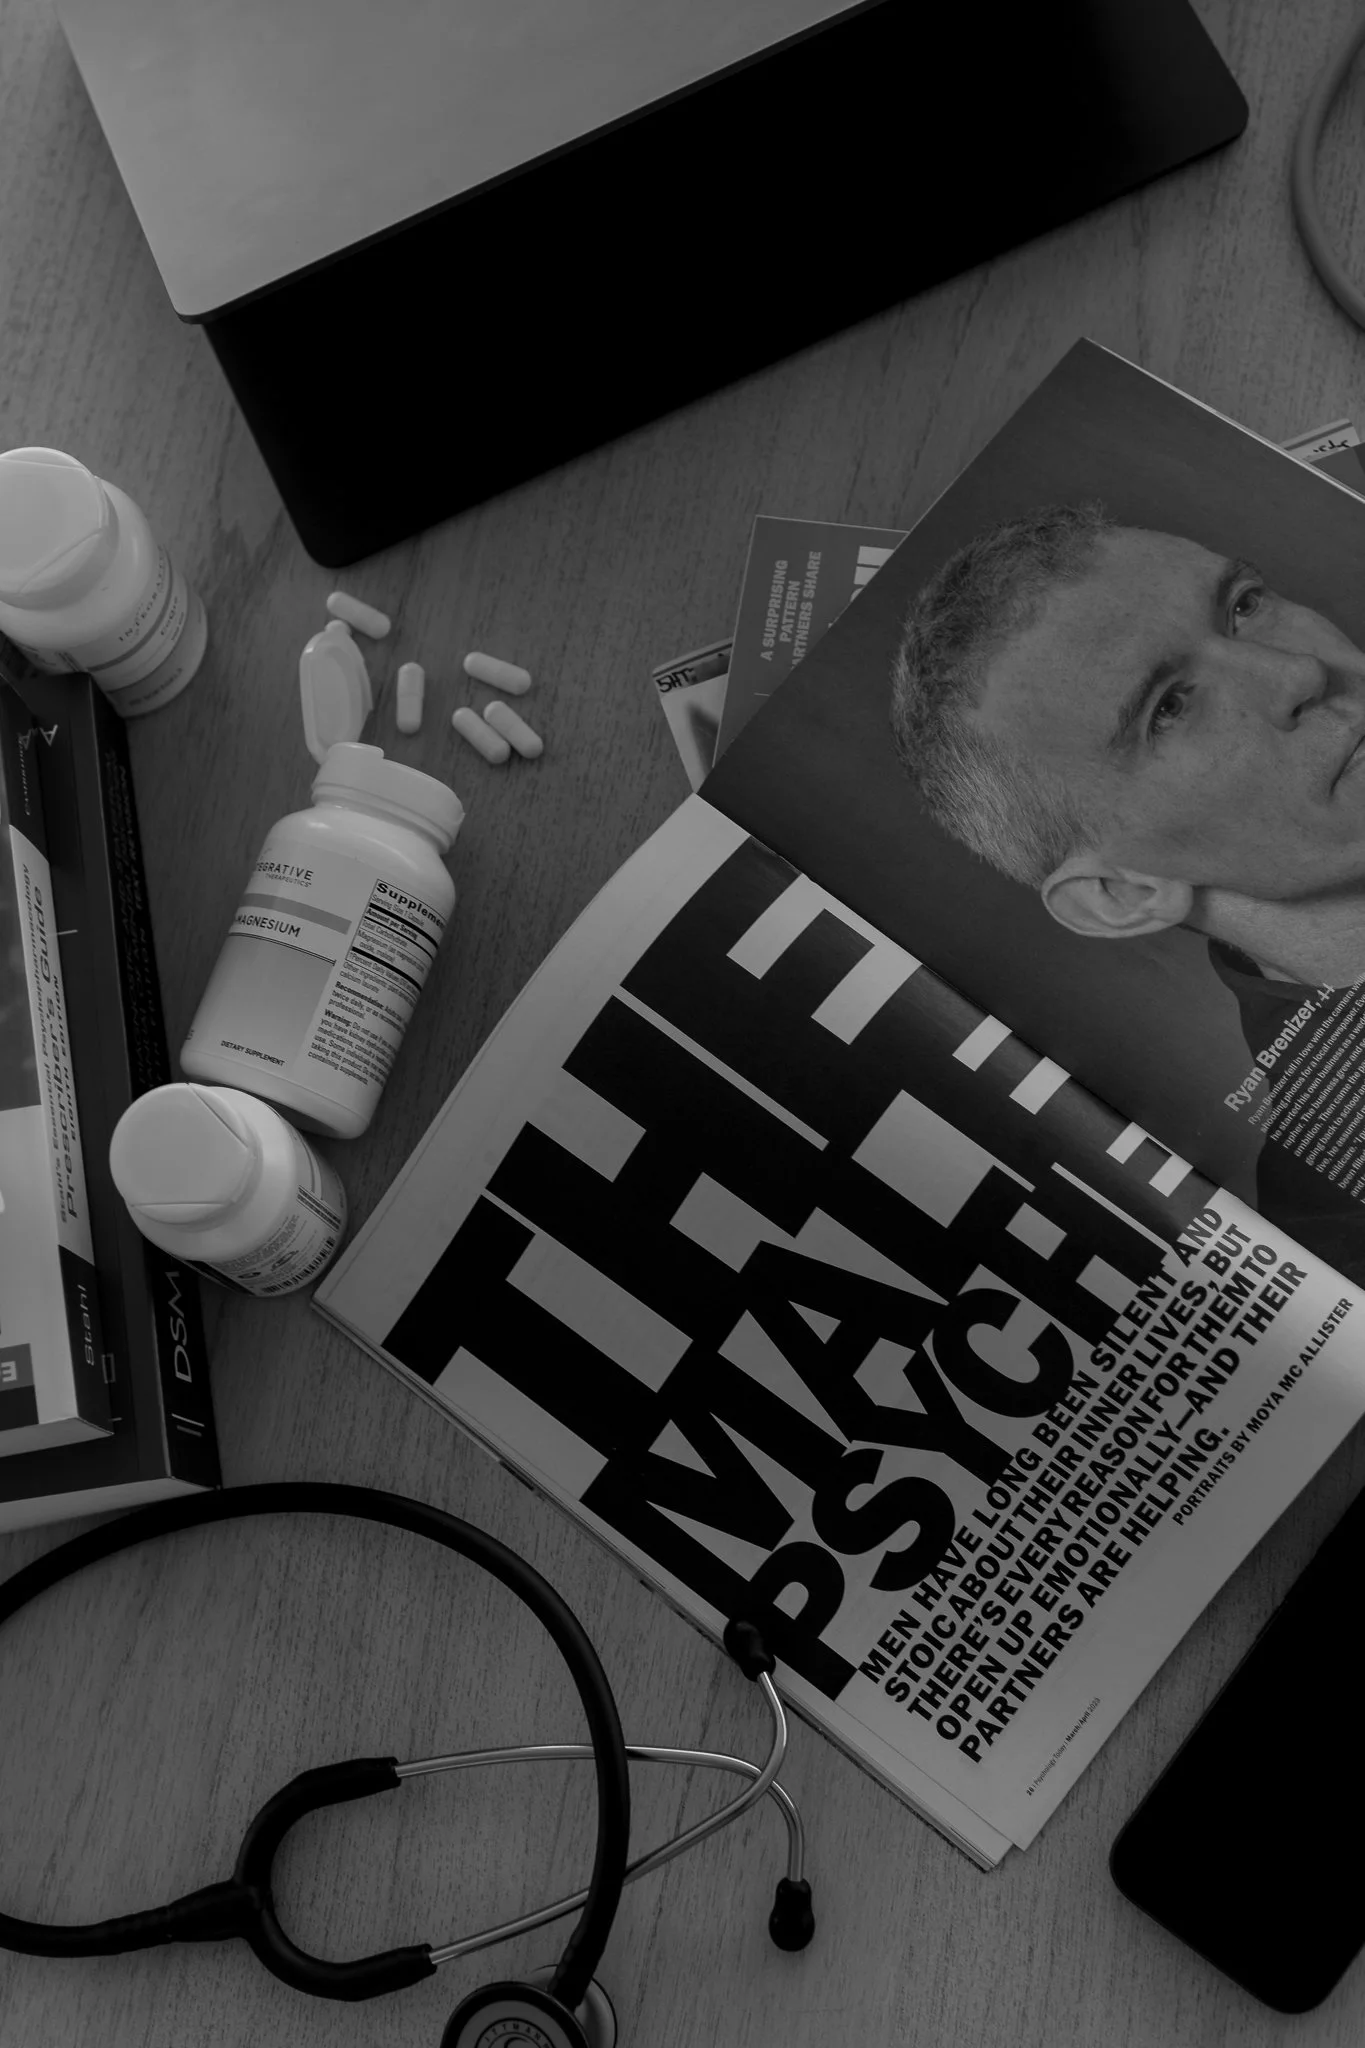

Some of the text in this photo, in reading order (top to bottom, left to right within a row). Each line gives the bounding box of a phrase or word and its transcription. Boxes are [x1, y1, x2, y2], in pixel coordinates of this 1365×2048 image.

[760, 560, 788, 661] A SURPRISING
[779, 580, 800, 642] PATTERN
[791, 551, 821, 669] ARTNERS SHARE
[34, 886, 78, 1219] Prescriber's Guide
[1224, 1067, 1266, 1111] Ryan
[1256, 999, 1322, 1069] Brenizer,
[1248, 1105, 1267, 1125] Ryan
[1261, 1075, 1288, 1107] Brenizer
[1284, 1063, 1297, 1076] fell
[1298, 1042, 1314, 1058] love
[1311, 1027, 1326, 1043] with
[1321, 1016, 1334, 1028] the
[1332, 990, 1355, 1017] camera
[1260, 1099, 1288, 1133] shooting
[1283, 1077, 1305, 1103] photos
[1301, 1065, 1313, 1077] for
[1312, 1043, 1330, 1062] local
[1327, 1007, 1359, 1045] newspaper.
[1270, 1130, 1282, 1141] he
[1279, 1102, 1302, 1130] started
[1297, 1092, 1310, 1105] his
[1307, 1077, 1322, 1093] own
[1317, 1047, 1345, 1078] business
[1282, 1045, 1363, 1149] rapher. The business grew and
[380, 835, 964, 1458] THE
[1294, 1123, 1323, 1156] ambition.
[1318, 1103, 1336, 1121] Then
[1333, 1083, 1352, 1104] came
[1347, 1071, 1360, 1084] the
[1305, 1142, 1325, 1166] going
[1319, 1125, 1338, 1144] back
[1340, 1093, 1361, 1118] school
[1327, 1146, 1339, 1157] he
[1336, 1112, 1364, 1147] assumed
[1337, 1169, 1356, 1189] been
[1350, 1180, 1365, 1197] and
[77, 1284, 95, 1367] Stahl
[164, 1270, 193, 1383] DSM
[580, 994, 1100, 1616] MALE
[726, 1098, 1220, 1700] PSYCHE
[858, 1207, 1223, 1684] MEN HAVE LONG BEEN SILENT AND
[1172, 1299, 1352, 1525] PORTRAITS BY MOYA MC ALLISTER
[885, 1224, 1251, 1702] STOIC ABOUT THEIR INNER LIVES, BUT
[907, 1245, 1277, 1720] THERE'S EVERY REASON FOR THEM TO
[937, 1654, 1007, 1740] OPEN
[996, 1610, 1034, 1655] UP
[1230, 1262, 1306, 1346] THEIR
[959, 1428, 1229, 1762] PARTNERS ARE HELPING.
